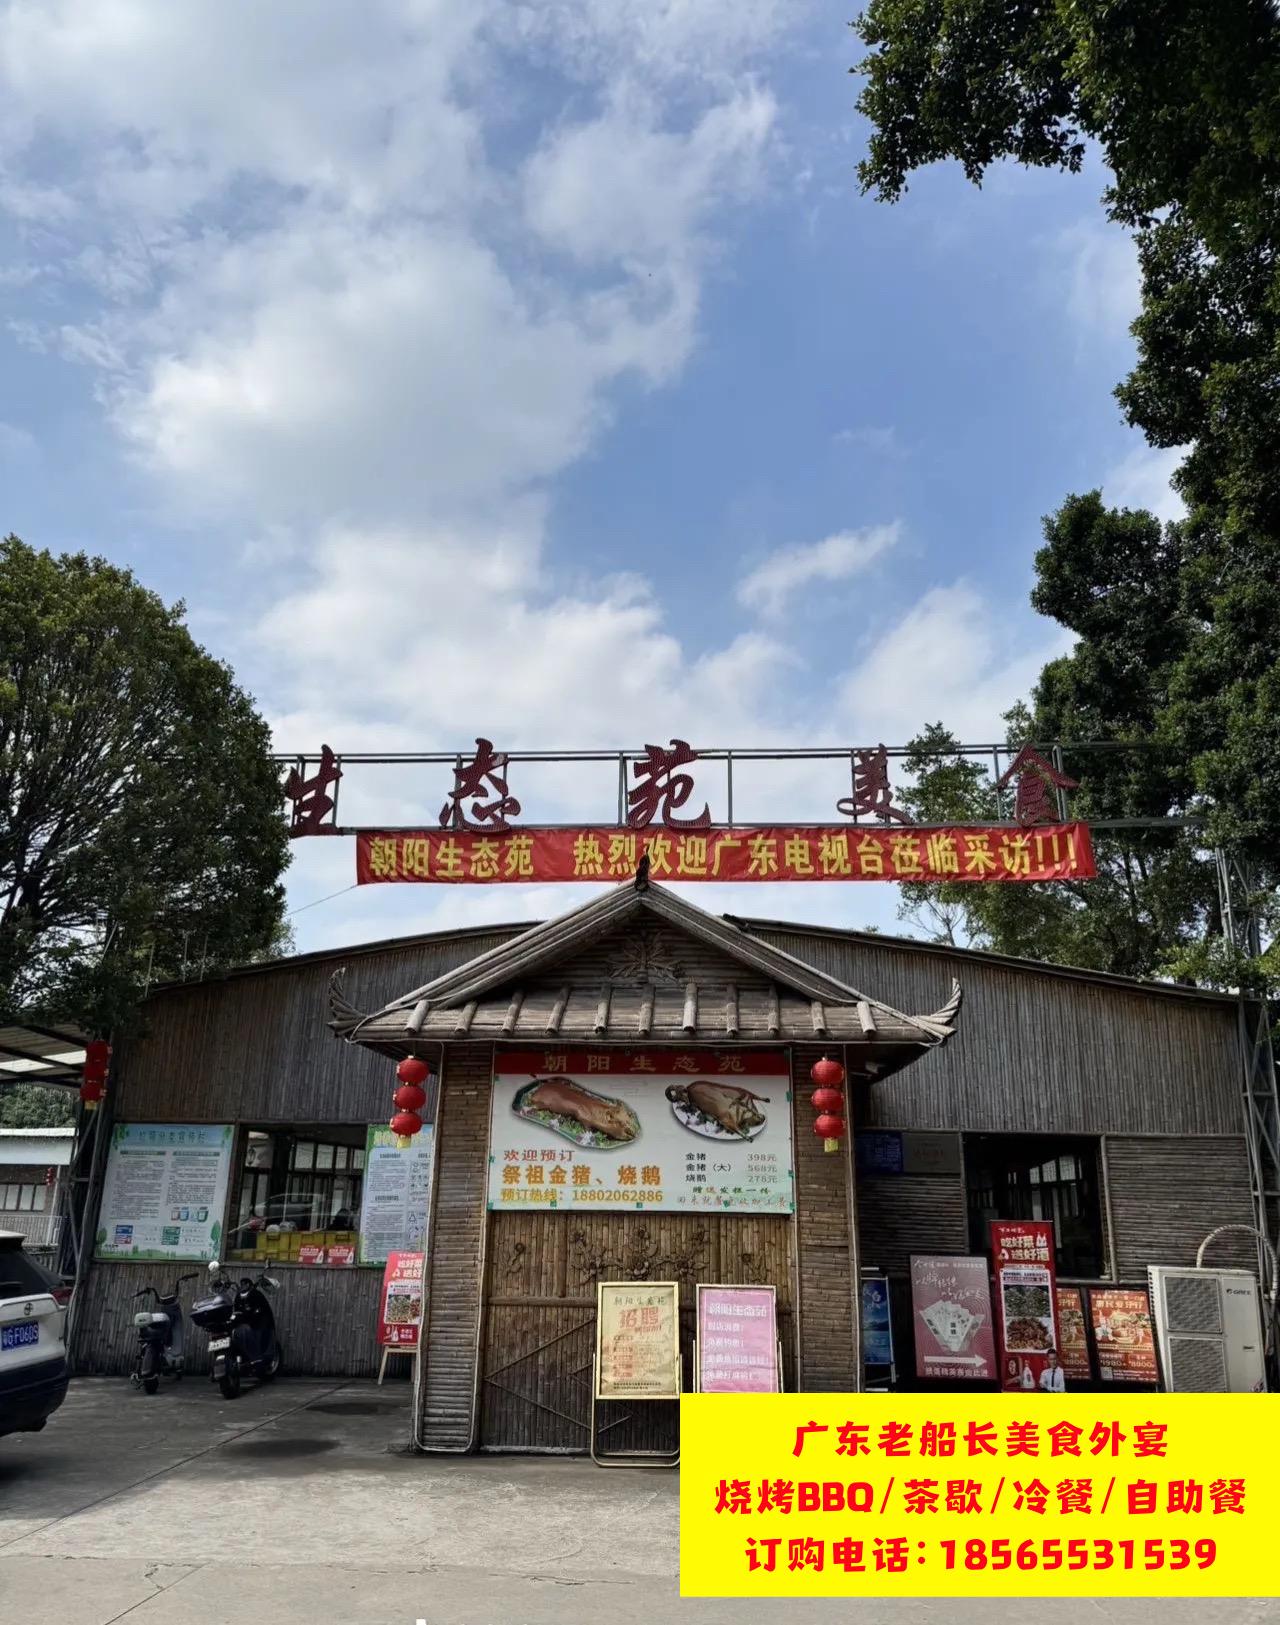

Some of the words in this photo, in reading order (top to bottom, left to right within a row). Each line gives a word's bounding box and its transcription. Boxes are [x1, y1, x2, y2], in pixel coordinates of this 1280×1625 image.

[369, 836, 534, 878] 朝阳生态苑
[541, 1053, 746, 1073] 朝阳生态苑
[503, 1149, 576, 1163] 欢迎预订
[685, 1152, 707, 1161] 金猪
